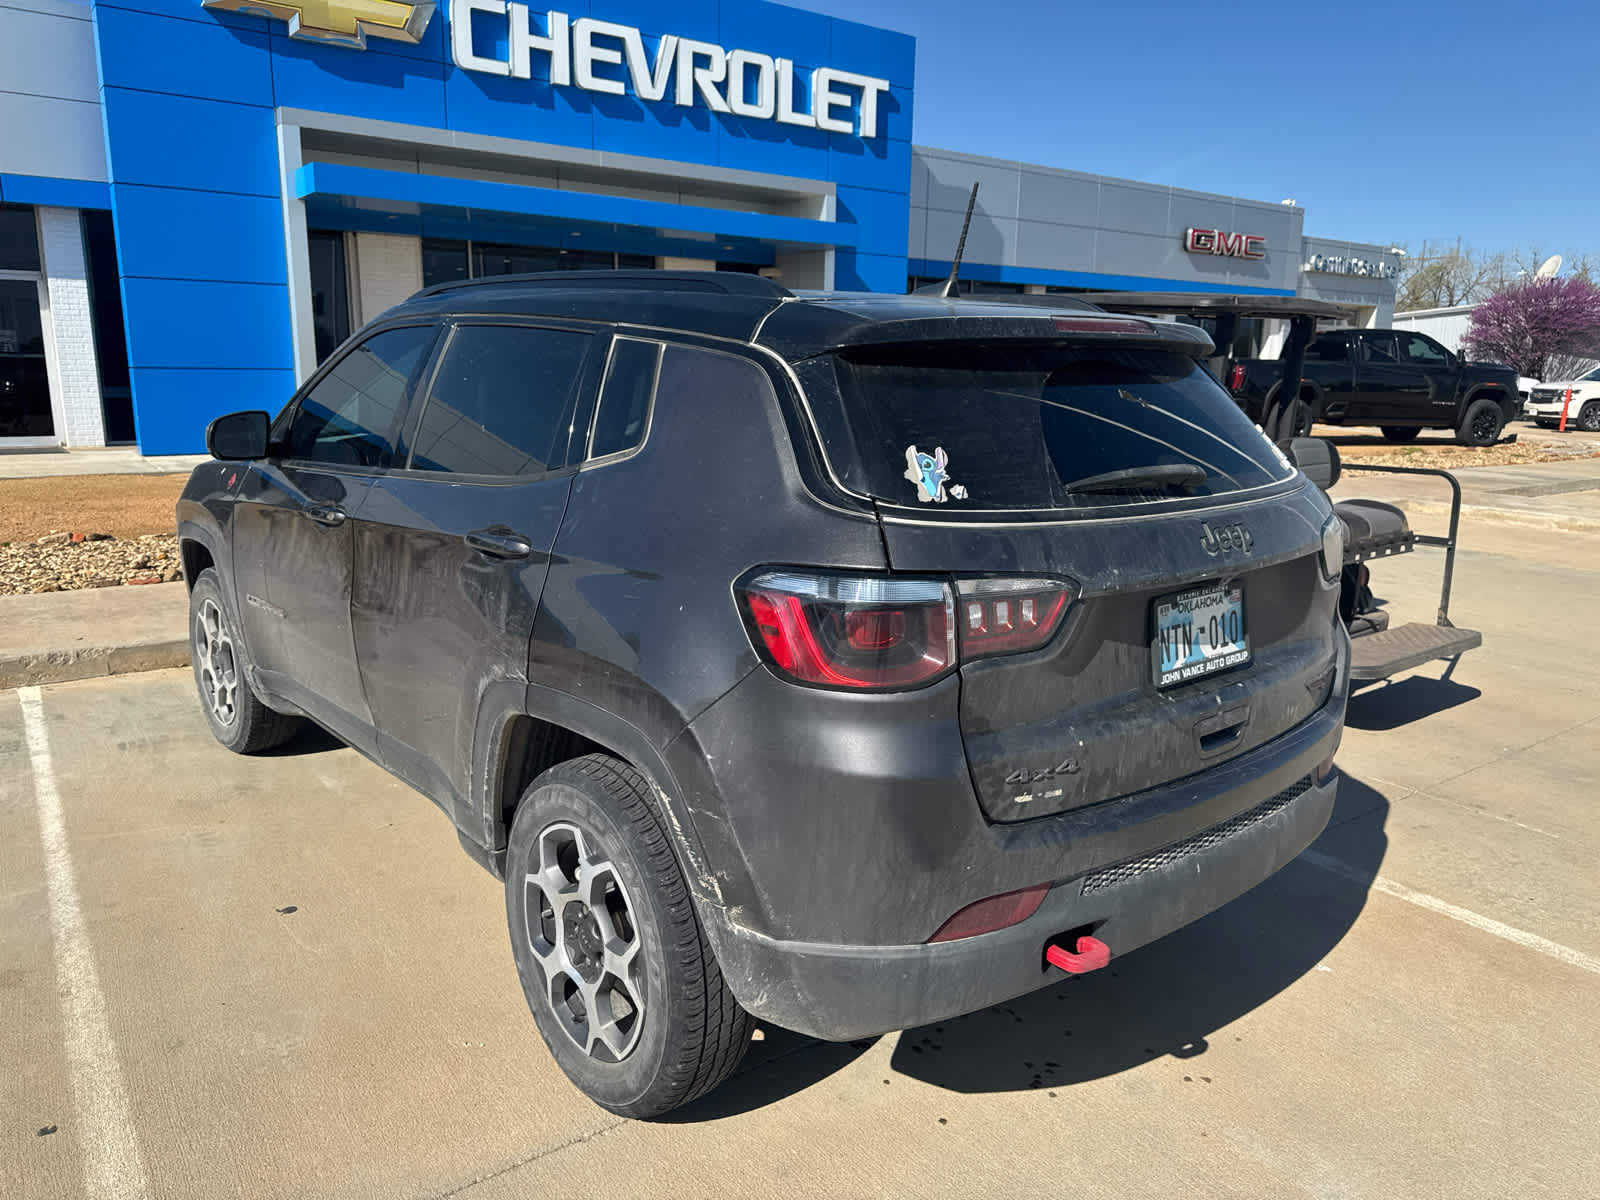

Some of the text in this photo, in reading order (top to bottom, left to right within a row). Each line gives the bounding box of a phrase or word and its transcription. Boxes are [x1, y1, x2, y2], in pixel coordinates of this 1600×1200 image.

[449, 0, 890, 139] CHEVROLET
[1185, 227, 1266, 260] GMC
[1200, 521, 1254, 557] Jeep
[1178, 594, 1224, 613] OKLAHOMA
[1161, 651, 1249, 685] JOHN VANCE AUTO GROUP
